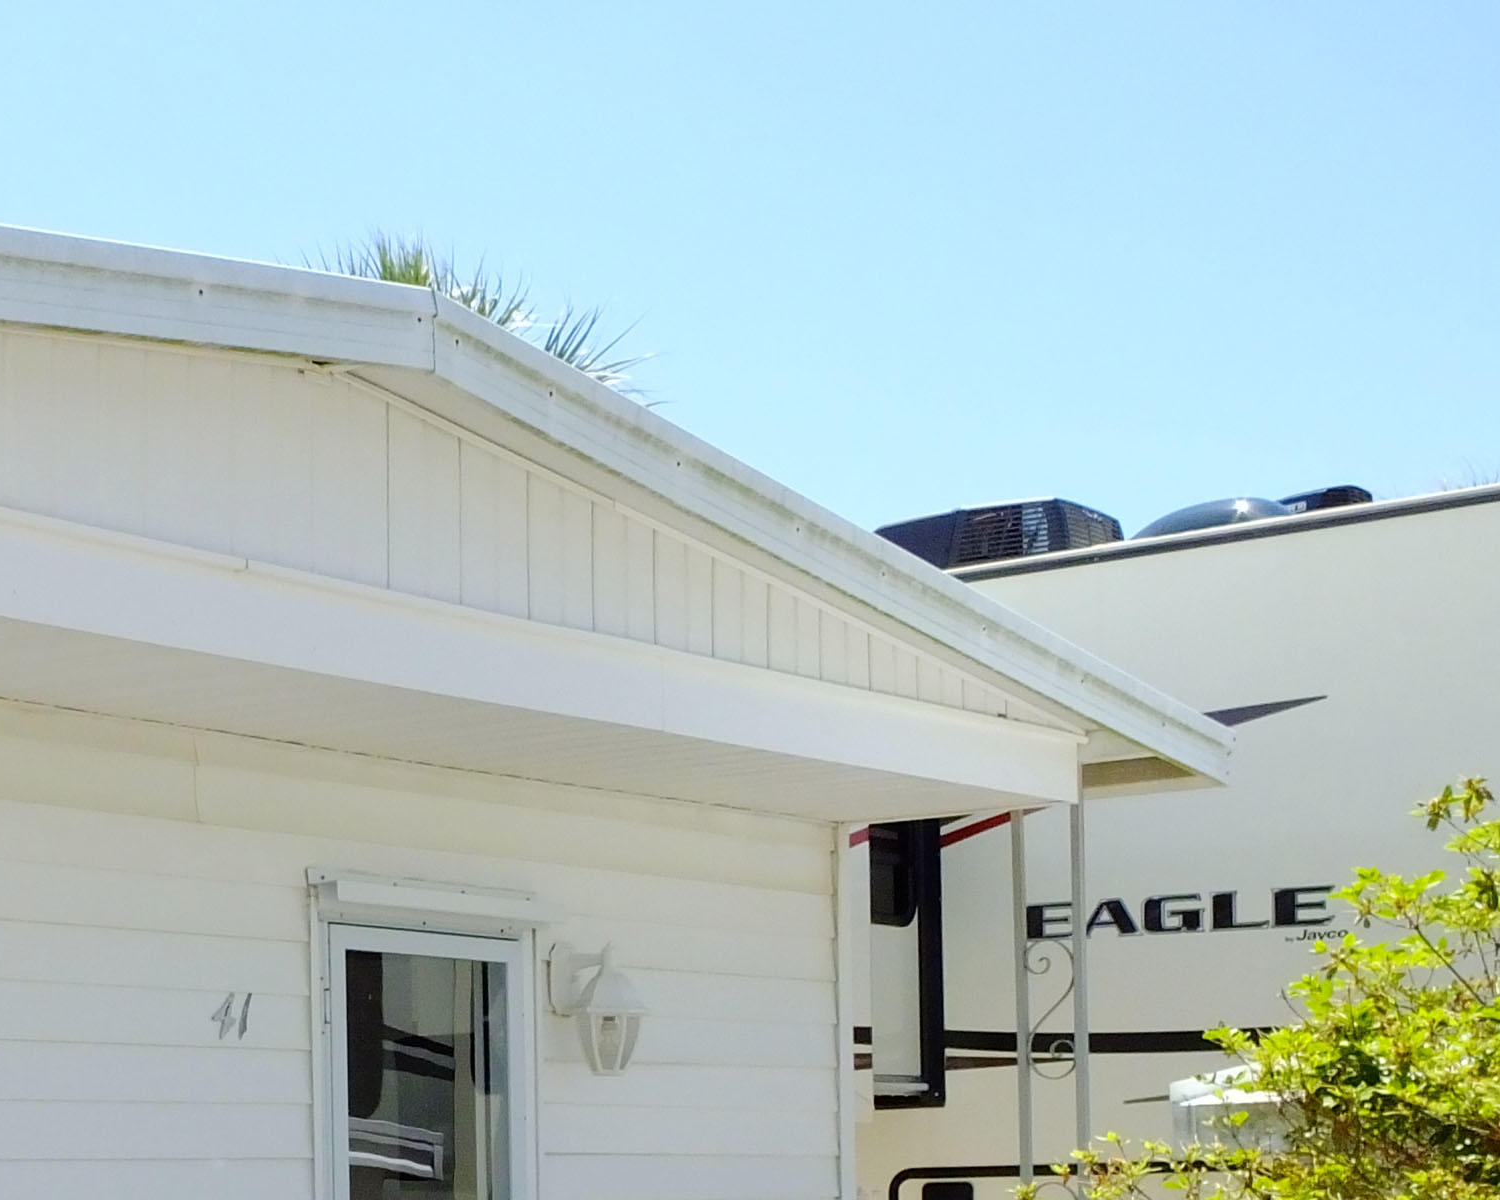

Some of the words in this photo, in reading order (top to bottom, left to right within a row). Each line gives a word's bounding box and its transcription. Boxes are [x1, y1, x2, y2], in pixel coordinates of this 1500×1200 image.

[1026, 884, 1336, 939] EAGLE
[1296, 929, 1349, 941] Jayco
[210, 992, 253, 1040] 41
